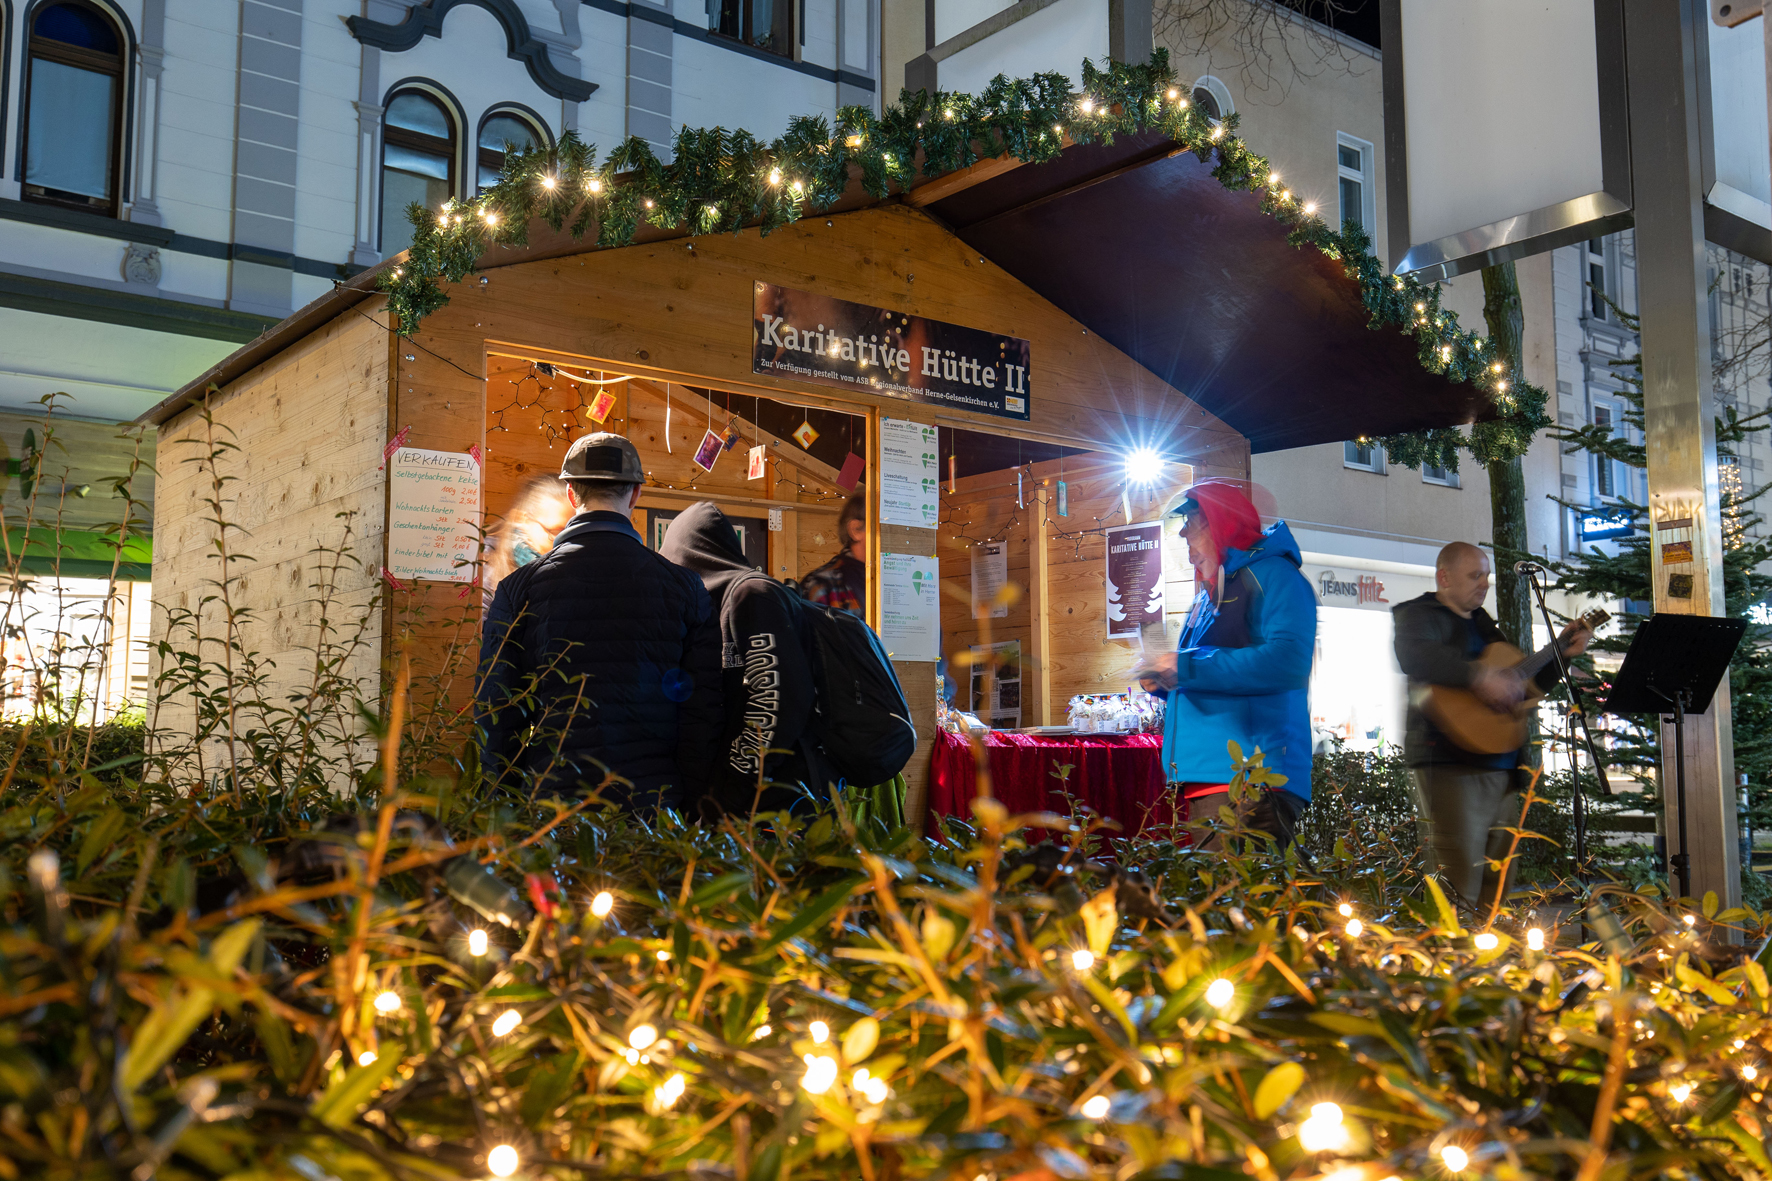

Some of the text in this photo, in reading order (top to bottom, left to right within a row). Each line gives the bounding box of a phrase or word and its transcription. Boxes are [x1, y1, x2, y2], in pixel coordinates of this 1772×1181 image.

[761, 313, 1025, 394] Karitative Hütte II
[760, 358, 774, 367] Zur
[774, 360, 812, 376] Verfügung
[813, 368, 838, 380] gestellt
[840, 374, 854, 383] vom
[856, 376, 869, 385] ASB
[870, 377, 924, 395] Regionalverband
[925, 388, 988, 407] Herne-Gelsenkirchen
[988, 401, 1000, 409] e.V.
[397, 450, 476, 471] VERKAUFEN
[441, 486, 456, 496] 100g
[1110, 542, 1138, 554] KARITATIVE
[1322, 580, 1358, 597] JEANS
